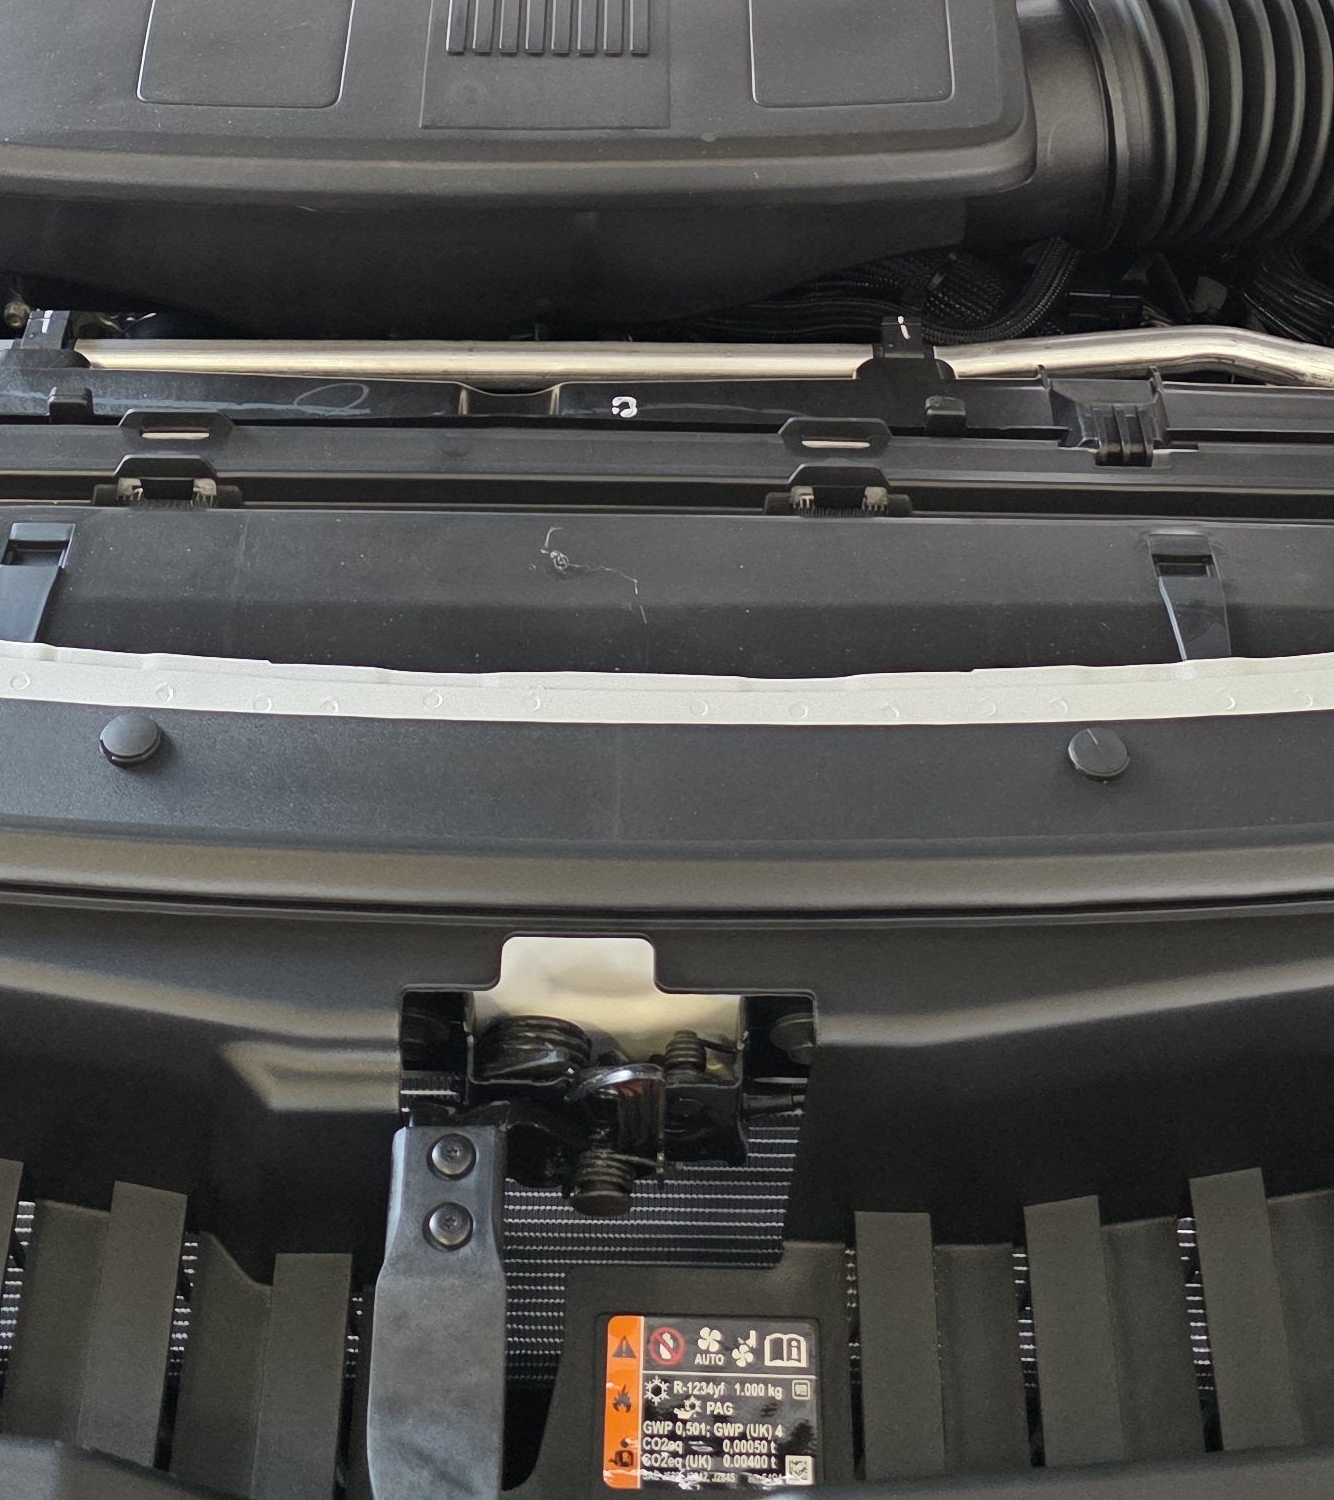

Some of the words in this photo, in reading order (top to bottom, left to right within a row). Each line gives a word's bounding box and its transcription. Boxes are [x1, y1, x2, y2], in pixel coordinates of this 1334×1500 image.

[694, 1353, 725, 1365] AUTO
[673, 1380, 727, 1398] R-1234yf
[734, 1382, 765, 1397] 1.000
[768, 1383, 783, 1400] kg
[706, 1401, 735, 1416] PAG
[642, 1420, 673, 1435] GWP
[675, 1421, 711, 1438] 0,501;
[713, 1422, 744, 1437] GWP
[746, 1424, 773, 1440] (UK)
[774, 1424, 784, 1438] 4
[642, 1436, 683, 1455] CO2eq
[722, 1439, 768, 1455] 0,00050
[770, 1440, 777, 1454] t
[641, 1452, 683, 1472] CO2eq
[686, 1454, 712, 1471] (UK)
[722, 1453, 769, 1468] 0.00400
[770, 1455, 777, 1469] t
